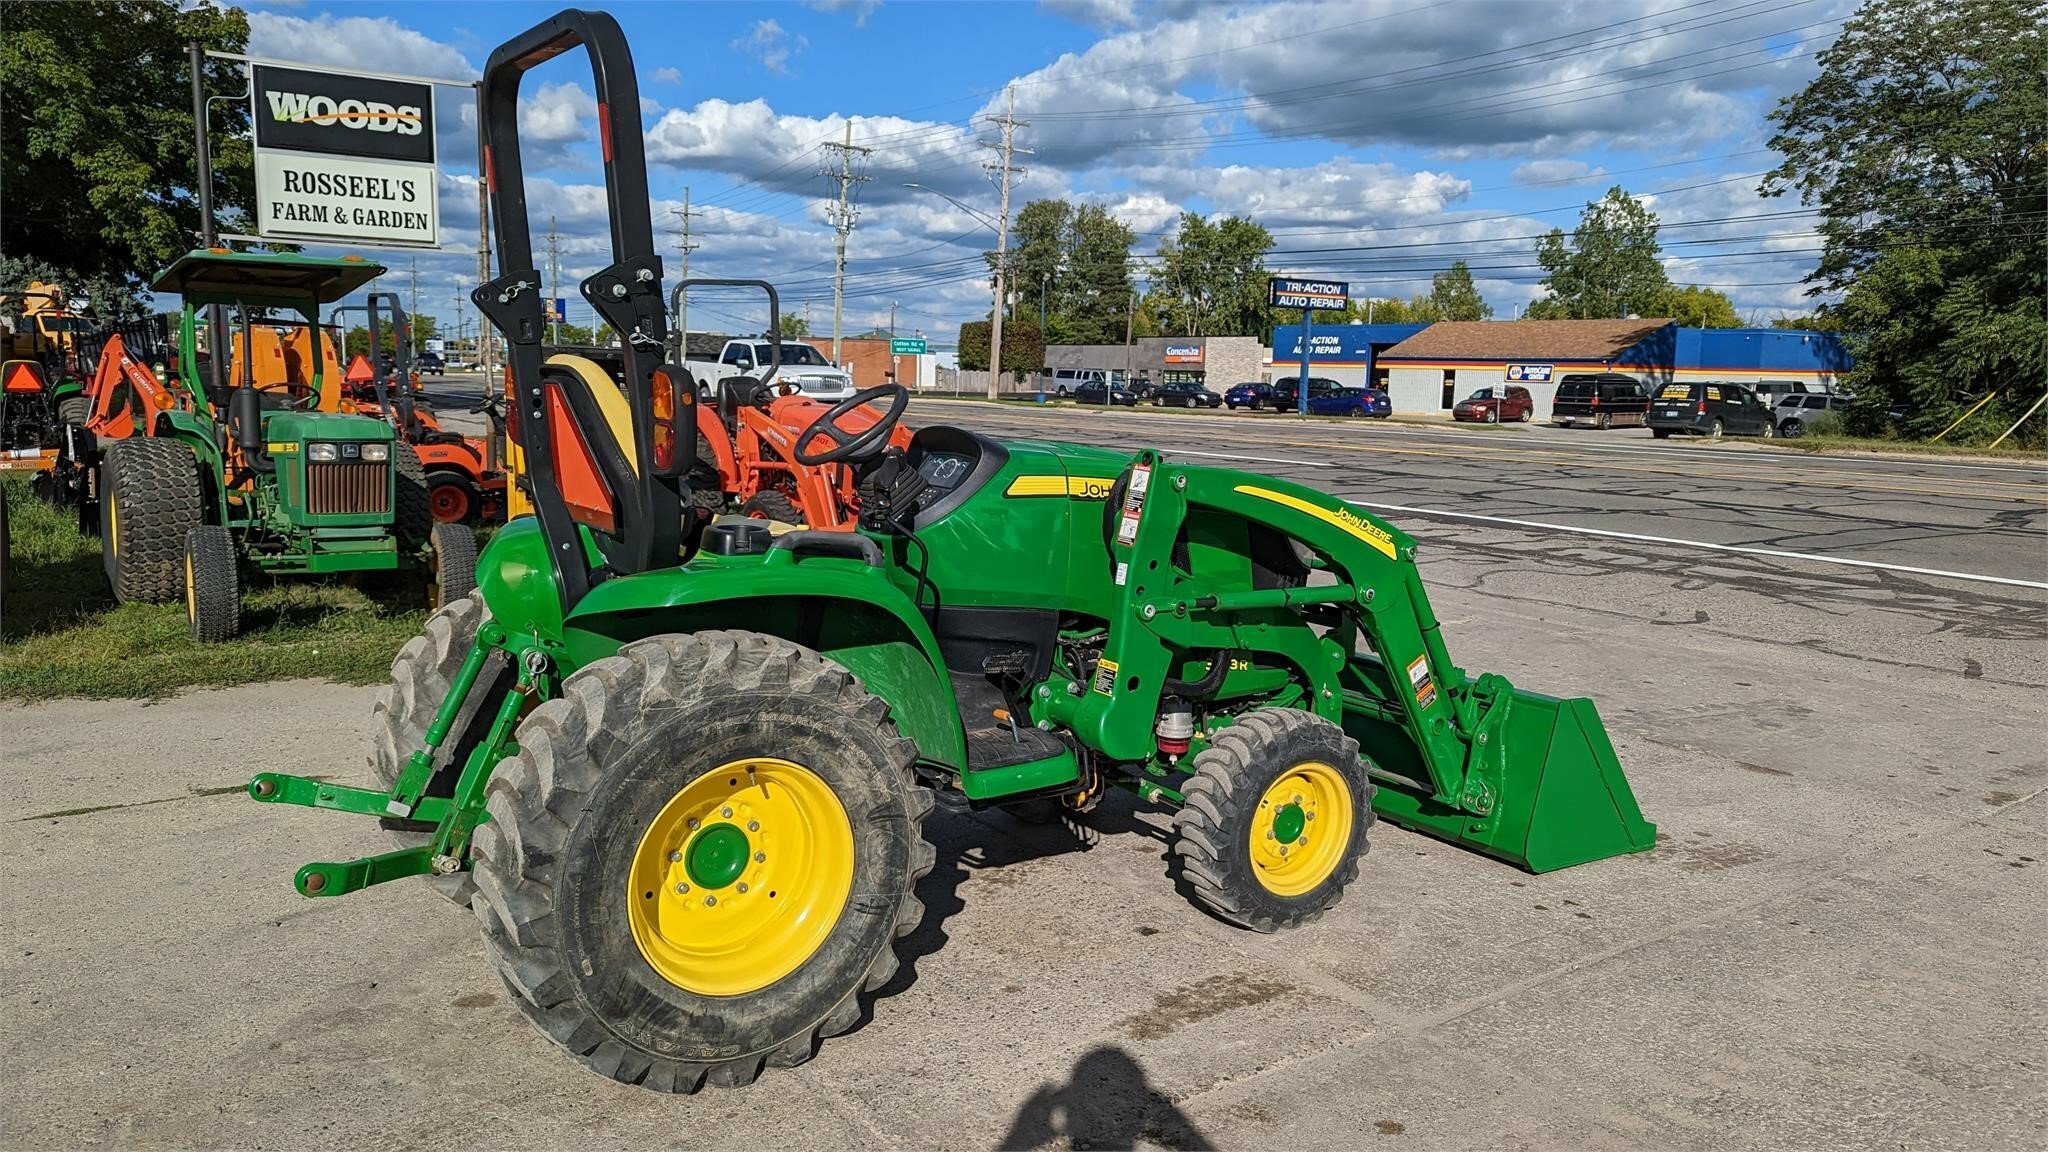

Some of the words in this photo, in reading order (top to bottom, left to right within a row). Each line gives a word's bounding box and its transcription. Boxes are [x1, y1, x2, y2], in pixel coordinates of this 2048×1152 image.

[265, 90, 423, 136] WOODS
[283, 170, 416, 203] ROSSEEL'S
[272, 202, 328, 223] FARM
[333, 206, 348, 225] &
[353, 208, 428, 230] GARDEN
[1285, 282, 1341, 294] TRI-ACTION
[1278, 296, 1307, 307] AUTO
[1309, 297, 1345, 308] REPAIR
[1297, 336, 1339, 345] T-ACTION
[1314, 346, 1342, 354] REPAIR
[133, 371, 154, 396] KUBOTA
[1079, 481, 1111, 497] JOH
[1333, 506, 1362, 529] JOHN
[1360, 518, 1393, 544] DEERE
